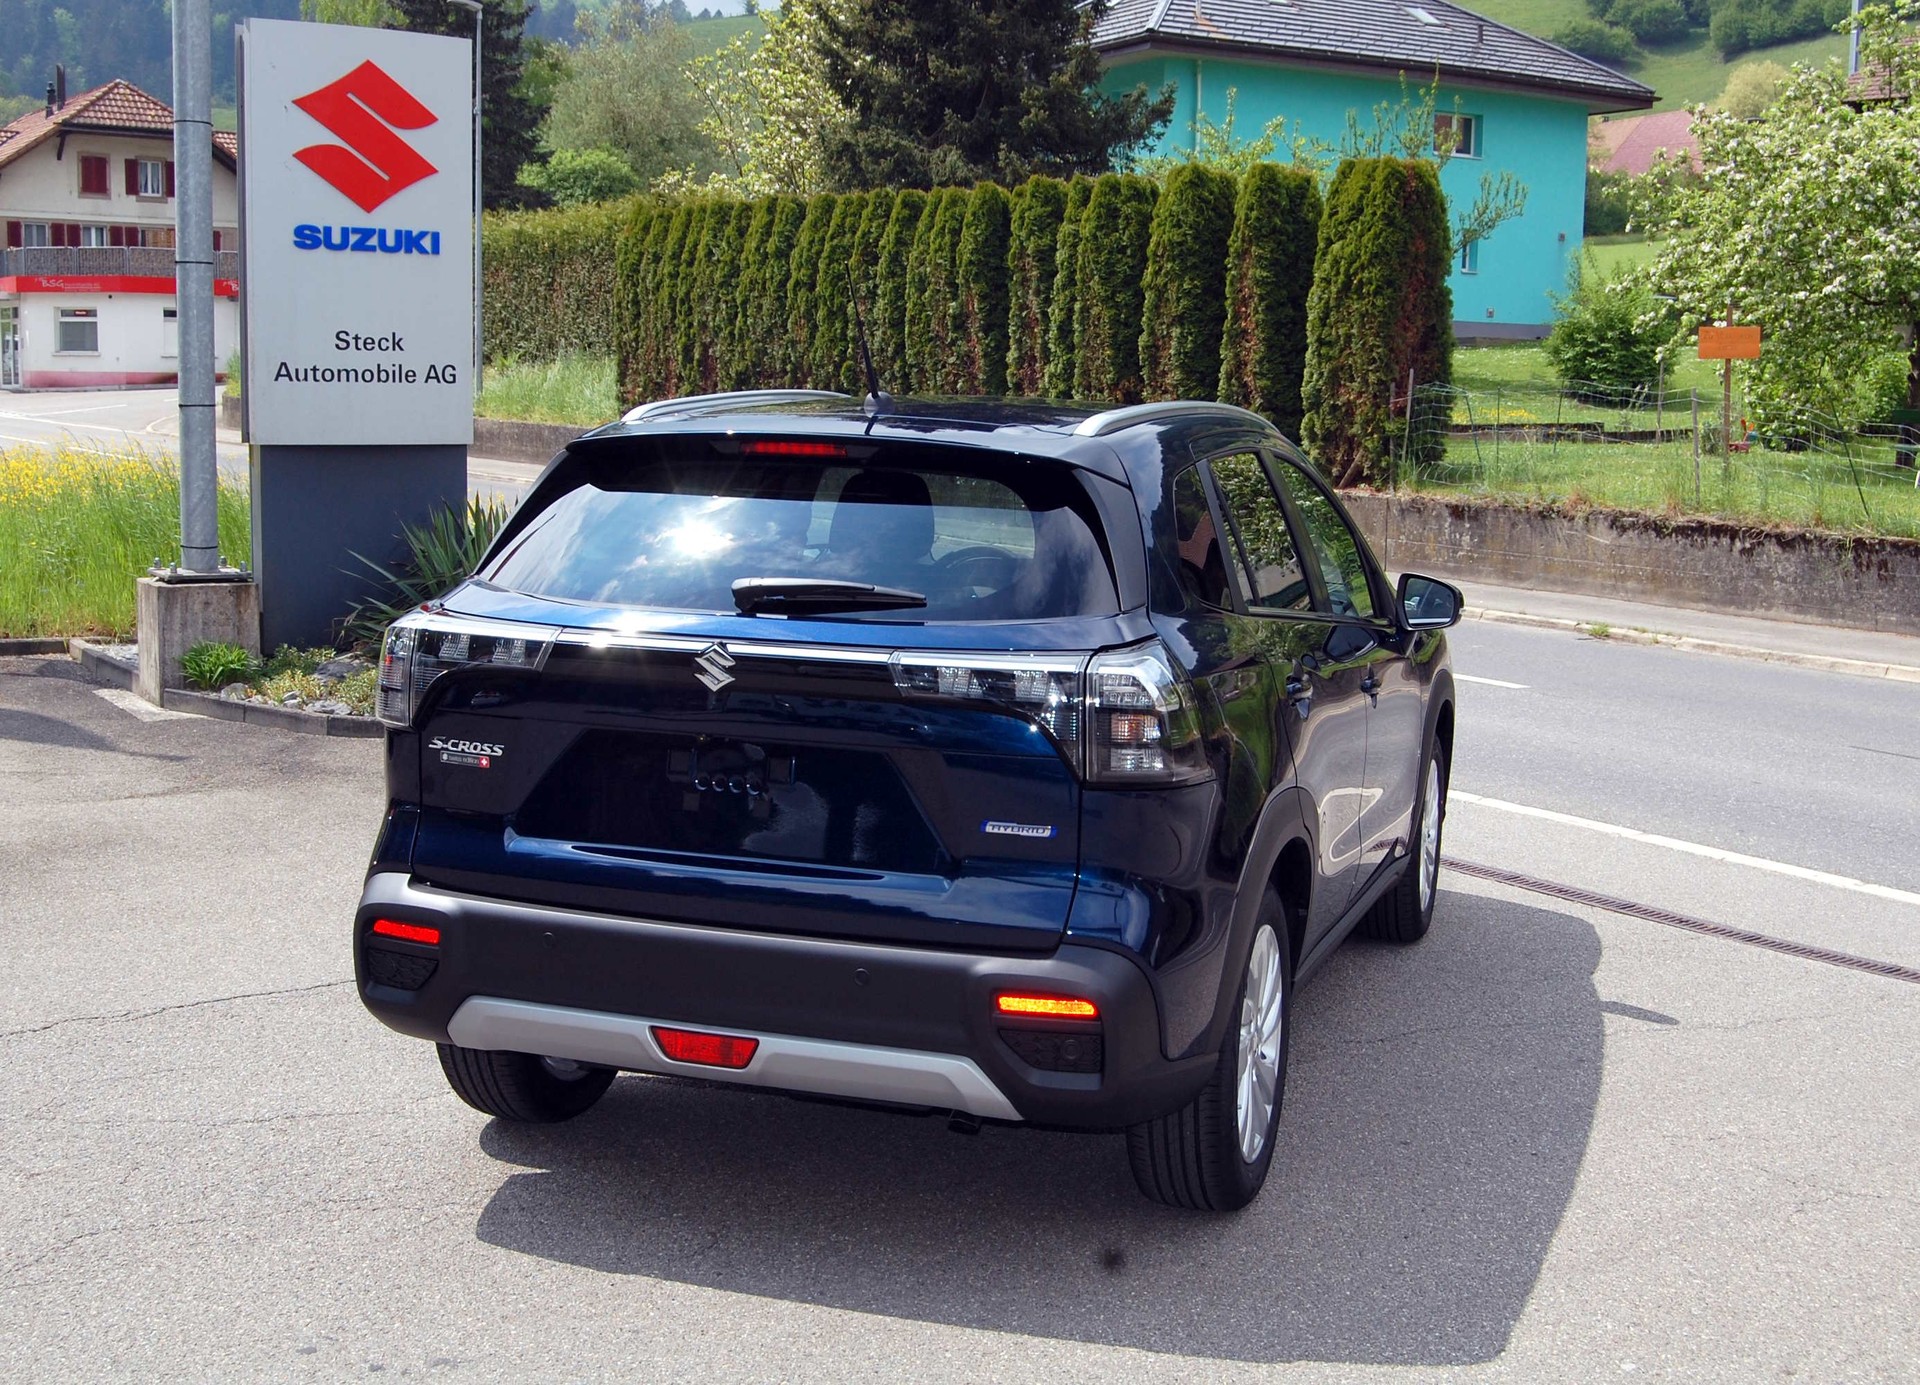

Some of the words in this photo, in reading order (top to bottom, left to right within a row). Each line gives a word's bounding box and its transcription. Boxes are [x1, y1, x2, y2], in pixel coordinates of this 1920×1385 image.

[293, 224, 440, 255] SUZUKI
[335, 330, 404, 351] Steck
[274, 361, 417, 384] Automobile
[424, 364, 457, 384] AG
[428, 736, 505, 756] S-CROSS
[988, 823, 1048, 836] HYBRID
